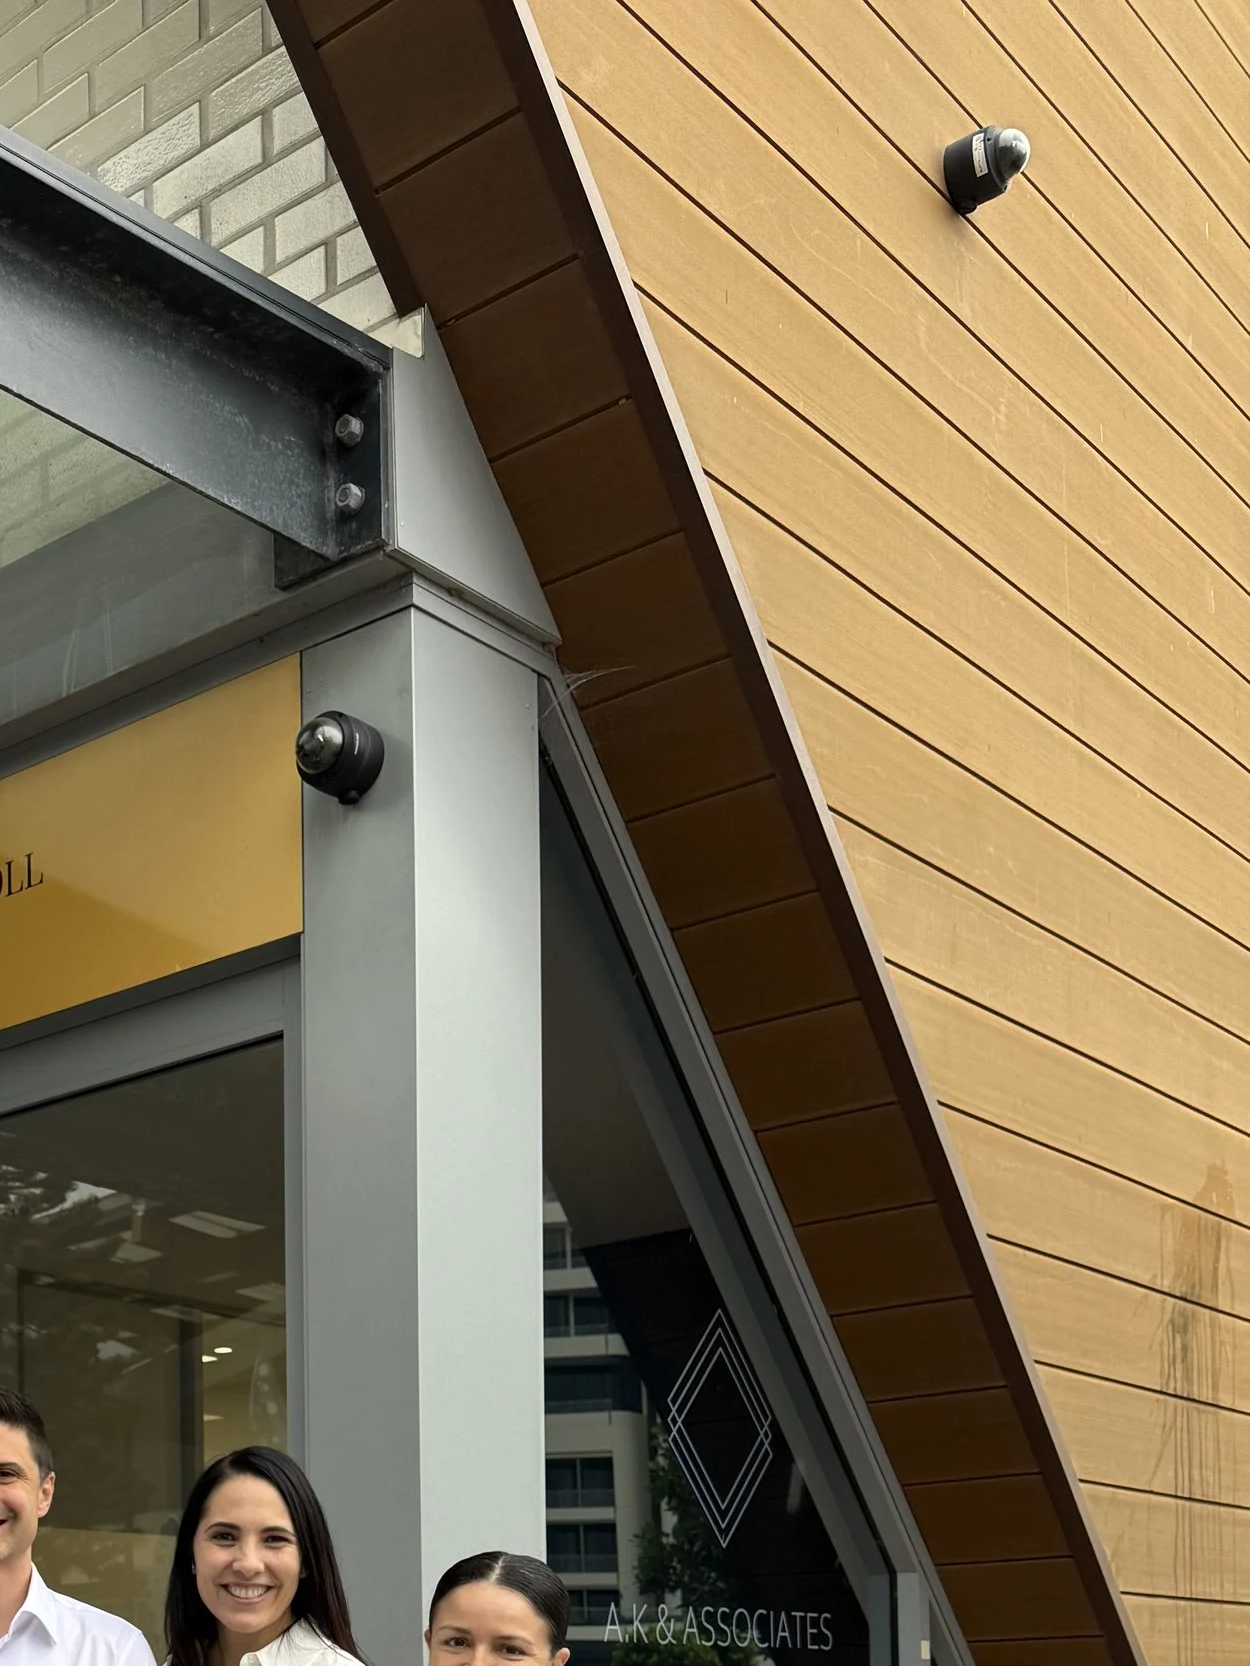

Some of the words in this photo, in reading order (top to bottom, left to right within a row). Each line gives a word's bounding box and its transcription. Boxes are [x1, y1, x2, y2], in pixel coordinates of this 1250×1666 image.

[603, 1601, 649, 1644] A.K
[656, 1603, 677, 1645] &
[683, 1605, 833, 1652] ASSOCIATES
